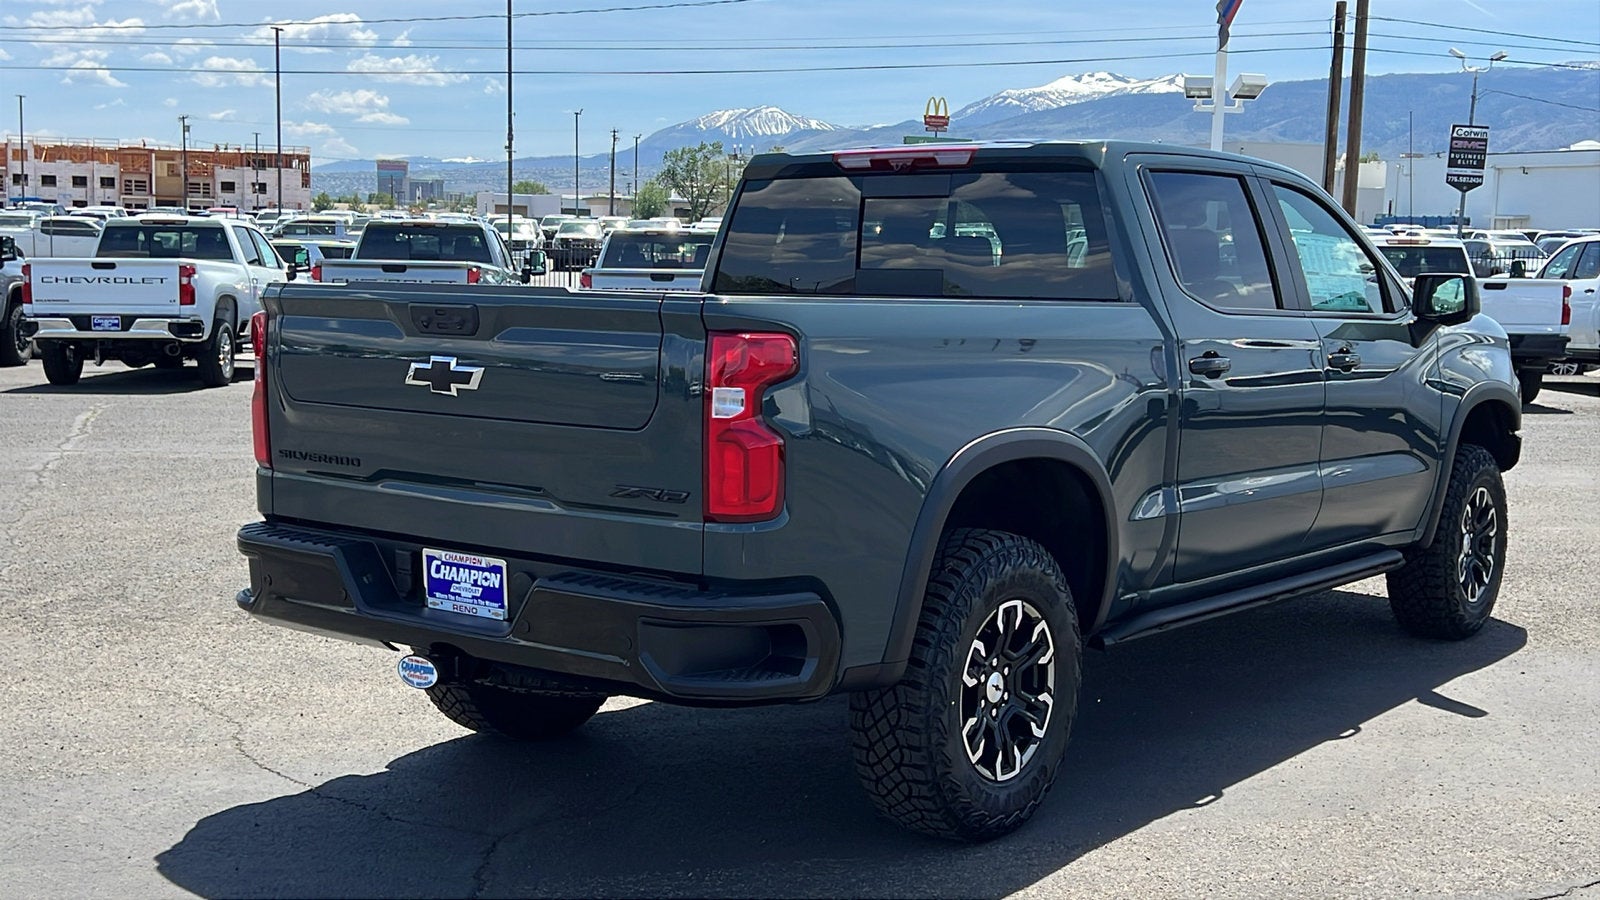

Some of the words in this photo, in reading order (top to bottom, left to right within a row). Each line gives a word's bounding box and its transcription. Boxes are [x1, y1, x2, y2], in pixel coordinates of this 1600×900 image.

[1456, 128, 1488, 137] Corwin
[1452, 140, 1486, 149] GMC
[41, 276, 168, 285] CHEVROLET
[278, 449, 361, 467] SILVERADO
[608, 484, 691, 504] ZR2
[444, 553, 482, 565] CHAMPION
[430, 560, 501, 588] CHAMPION
[452, 585, 480, 594] CHEVROLET
[452, 604, 478, 614] RENO
